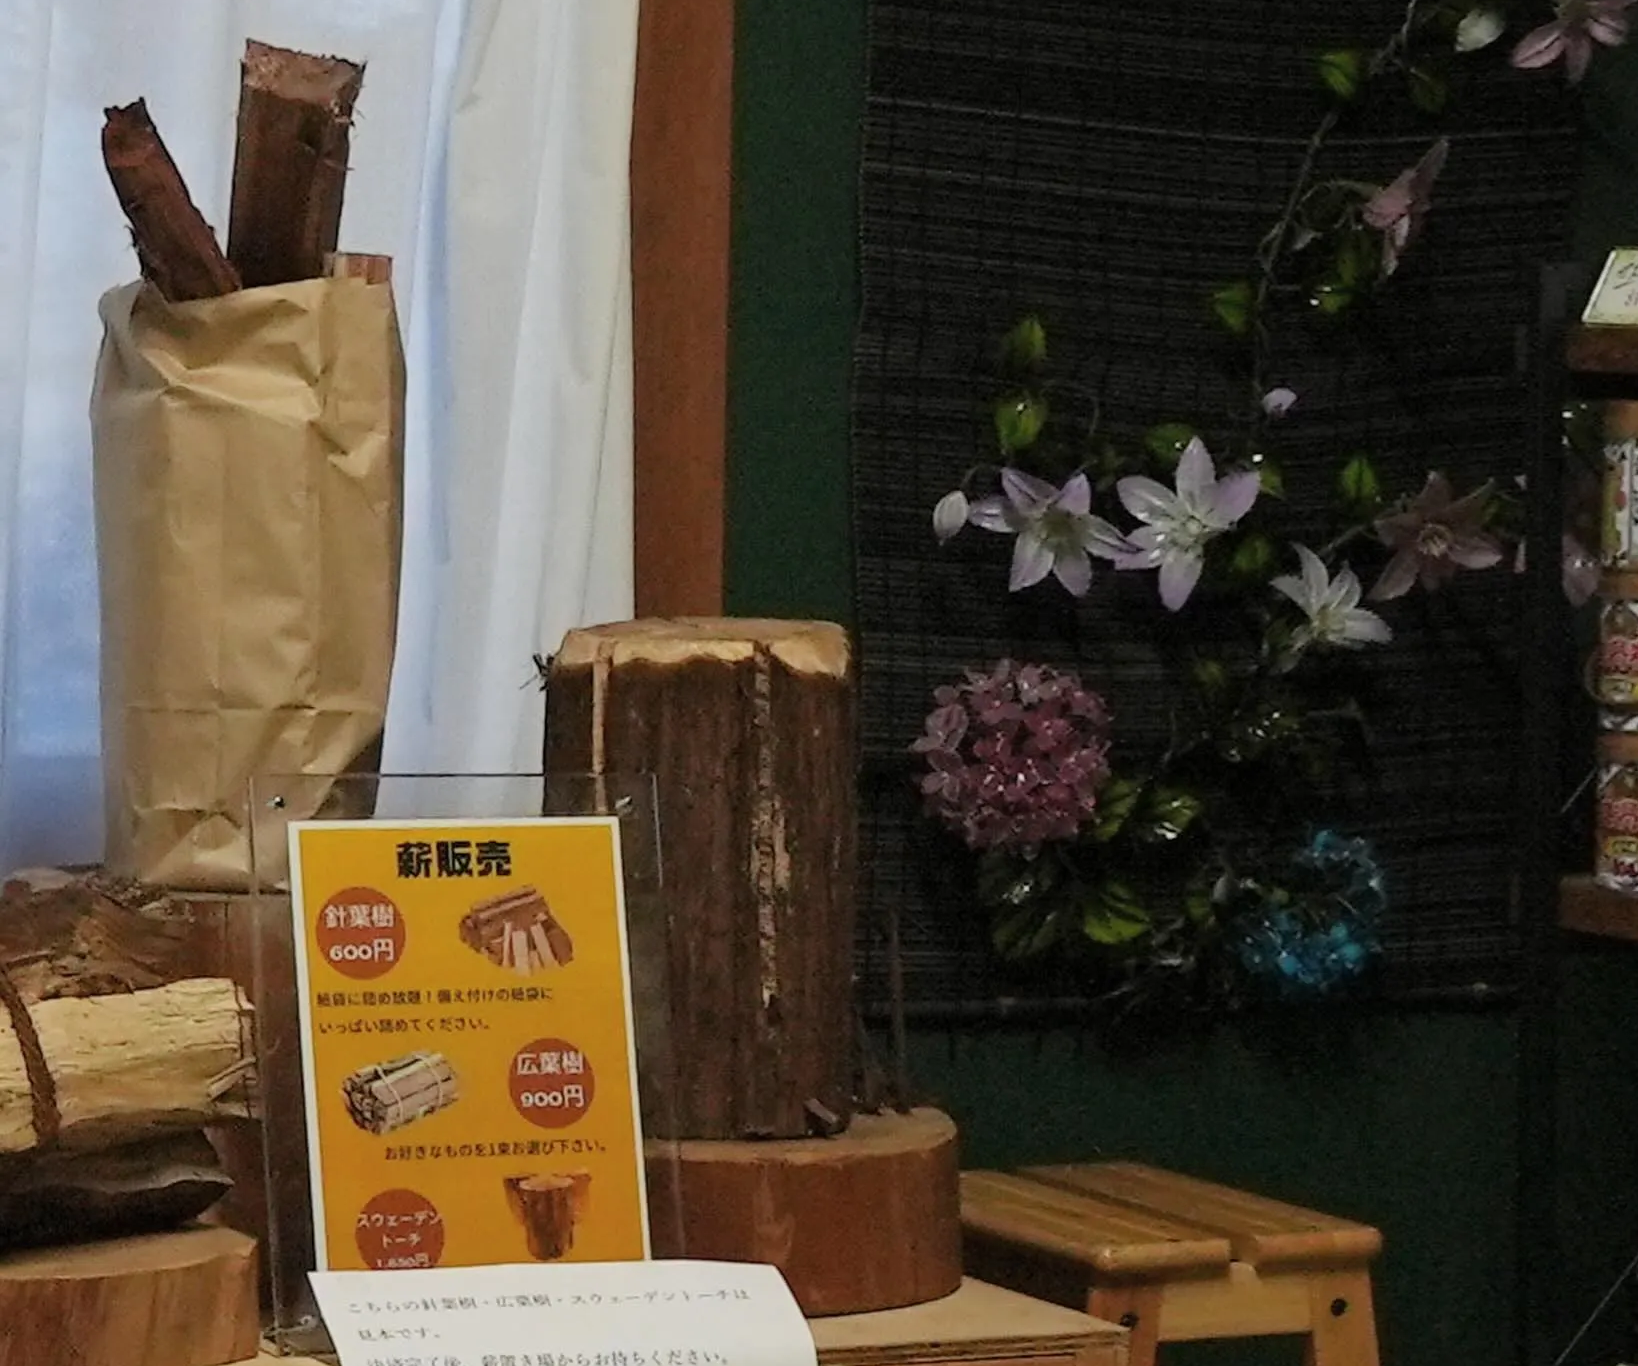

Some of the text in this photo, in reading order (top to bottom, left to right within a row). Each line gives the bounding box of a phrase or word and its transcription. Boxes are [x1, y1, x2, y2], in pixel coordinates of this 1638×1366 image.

[396, 841, 512, 878] 薪販売
[323, 903, 395, 929] 針葉樹
[329, 938, 395, 963] 600円
[516, 1051, 585, 1076] 広葉樹
[520, 1085, 586, 1109] 900円
[357, 1212, 442, 1229] スウェーデン
[381, 1233, 422, 1249] トーチ
